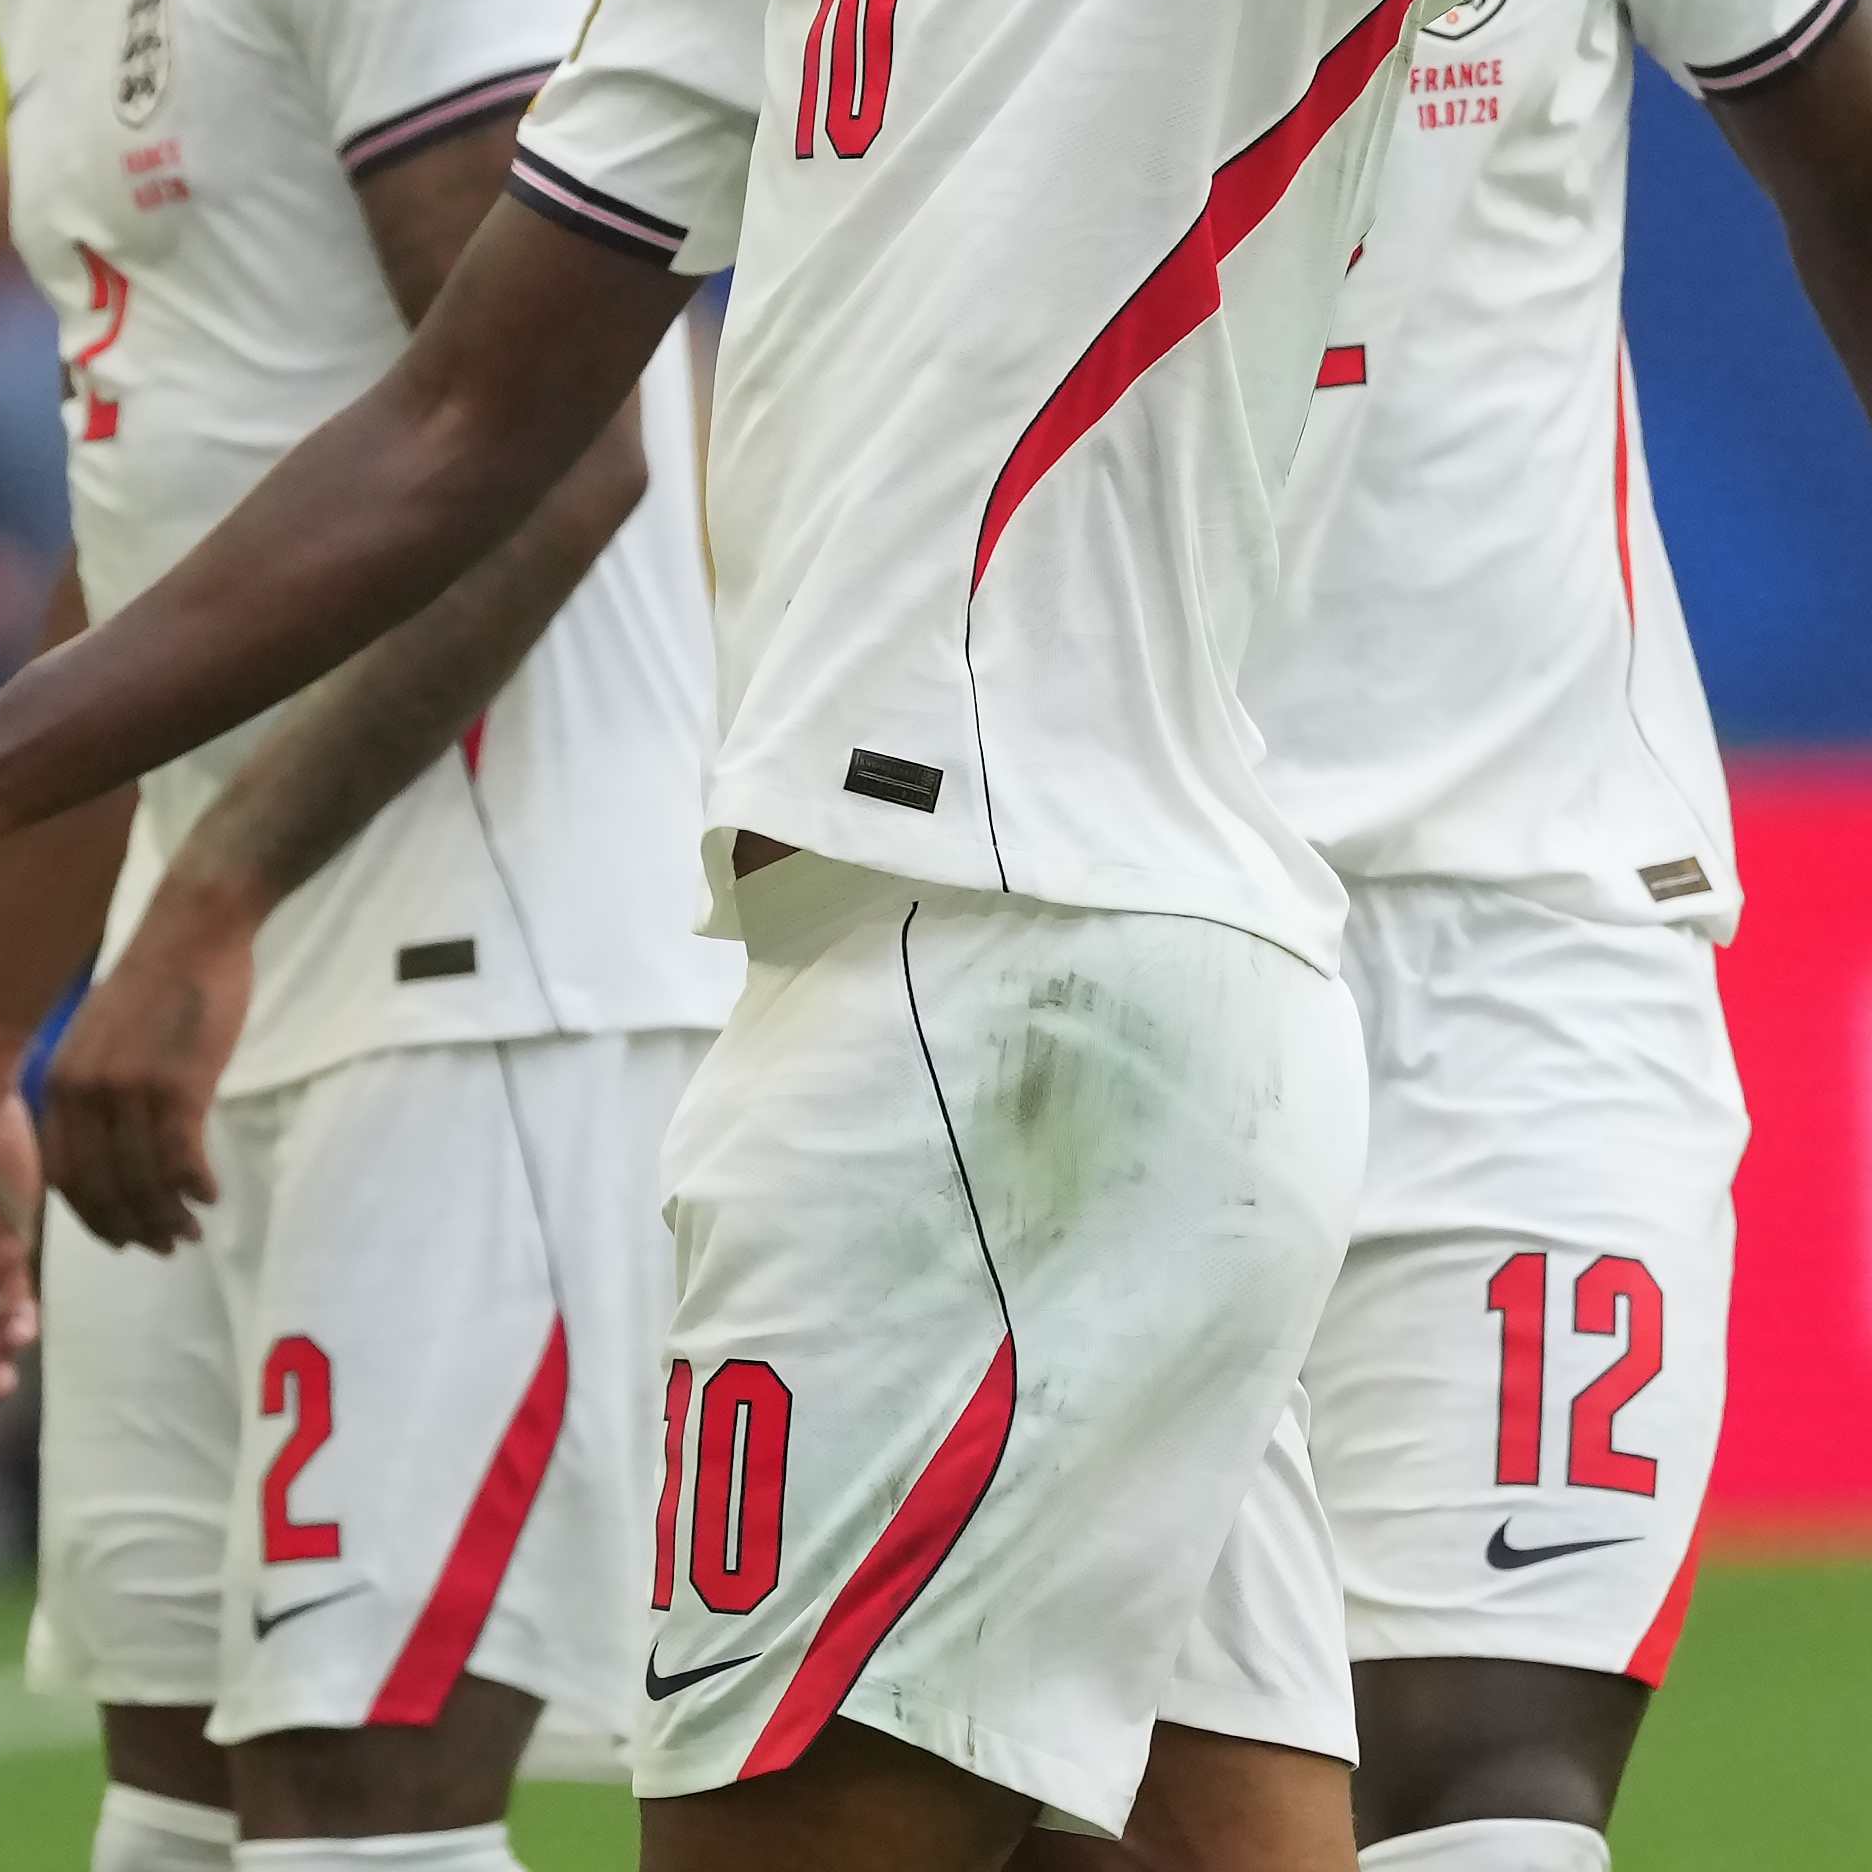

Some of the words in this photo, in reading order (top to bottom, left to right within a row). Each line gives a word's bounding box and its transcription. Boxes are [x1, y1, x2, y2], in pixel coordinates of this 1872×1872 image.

[1409, 59, 1504, 95] FRANCE
[72, 240, 129, 443] 2
[261, 1335, 341, 1565] 2
[652, 1358, 793, 1615] 10
[1486, 1252, 1665, 1499] 12
